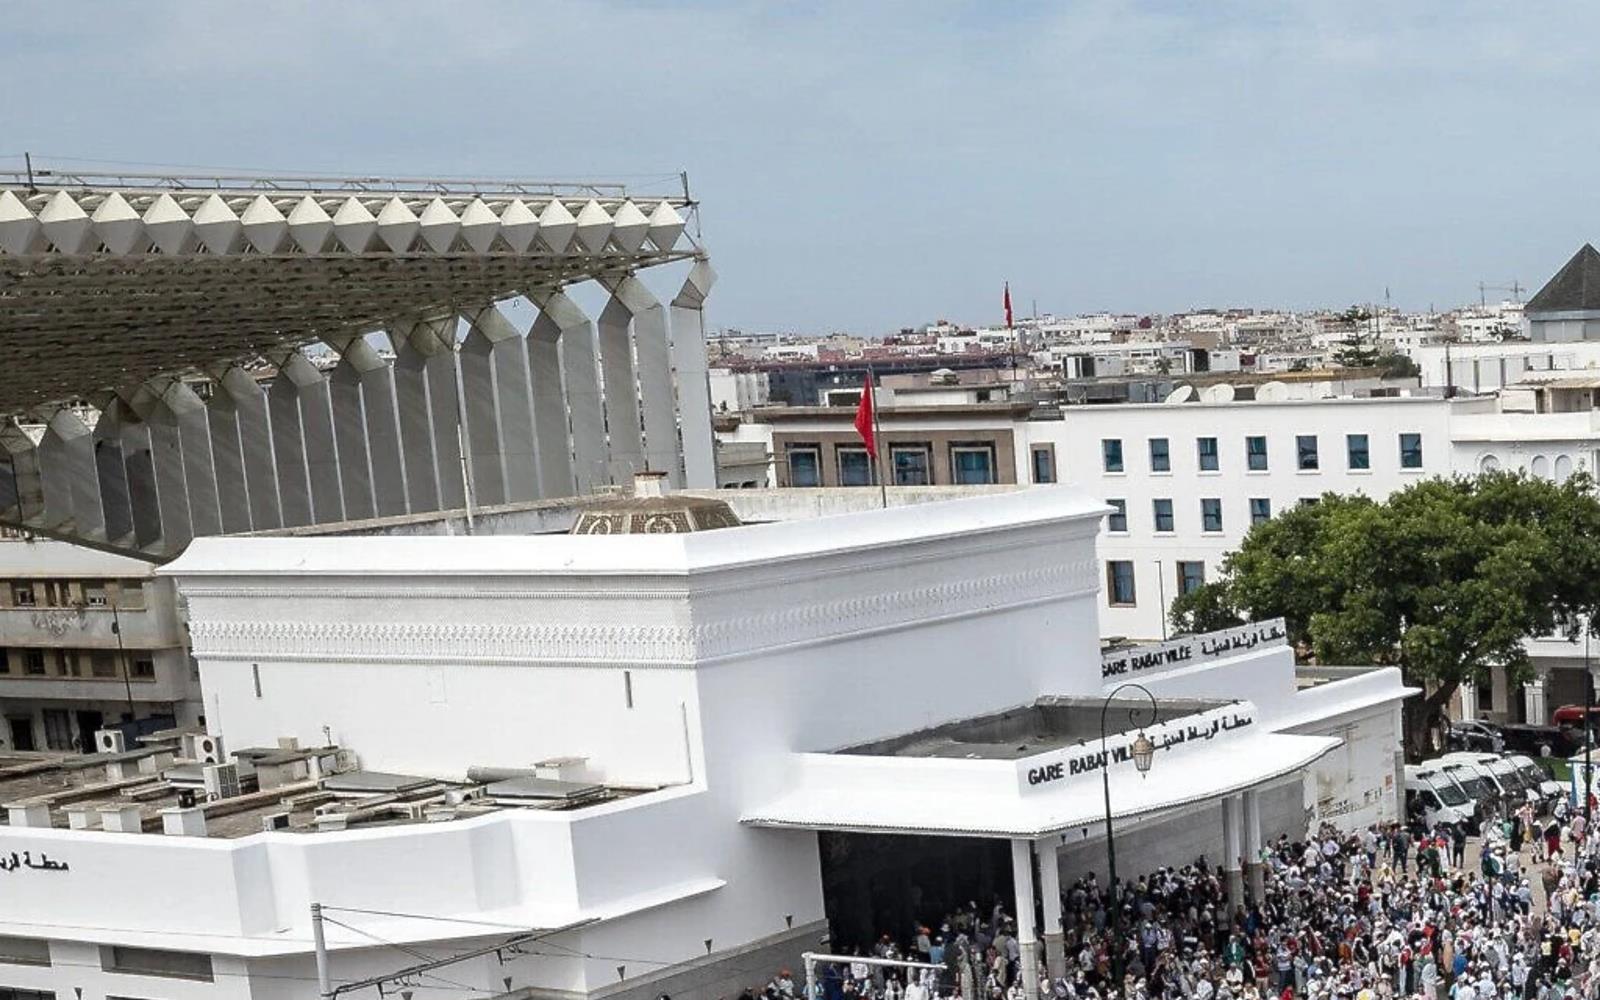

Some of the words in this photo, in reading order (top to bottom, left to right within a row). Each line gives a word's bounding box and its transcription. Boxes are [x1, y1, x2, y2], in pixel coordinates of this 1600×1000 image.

[1232, 632, 1258, 649] الرباط
[1260, 626, 1286, 642] محطة
[1202, 638, 1230, 656] المدينة
[1132, 653, 1163, 671] RABAT
[1162, 646, 1192, 663] VILLE
[1187, 719, 1219, 740] الرباط
[1221, 714, 1252, 731] محطة
[1150, 729, 1185, 751] المدينة
[1028, 763, 1065, 785] GARE
[1069, 751, 1109, 775] RABAT
[23, 851, 69, 871] محطة
